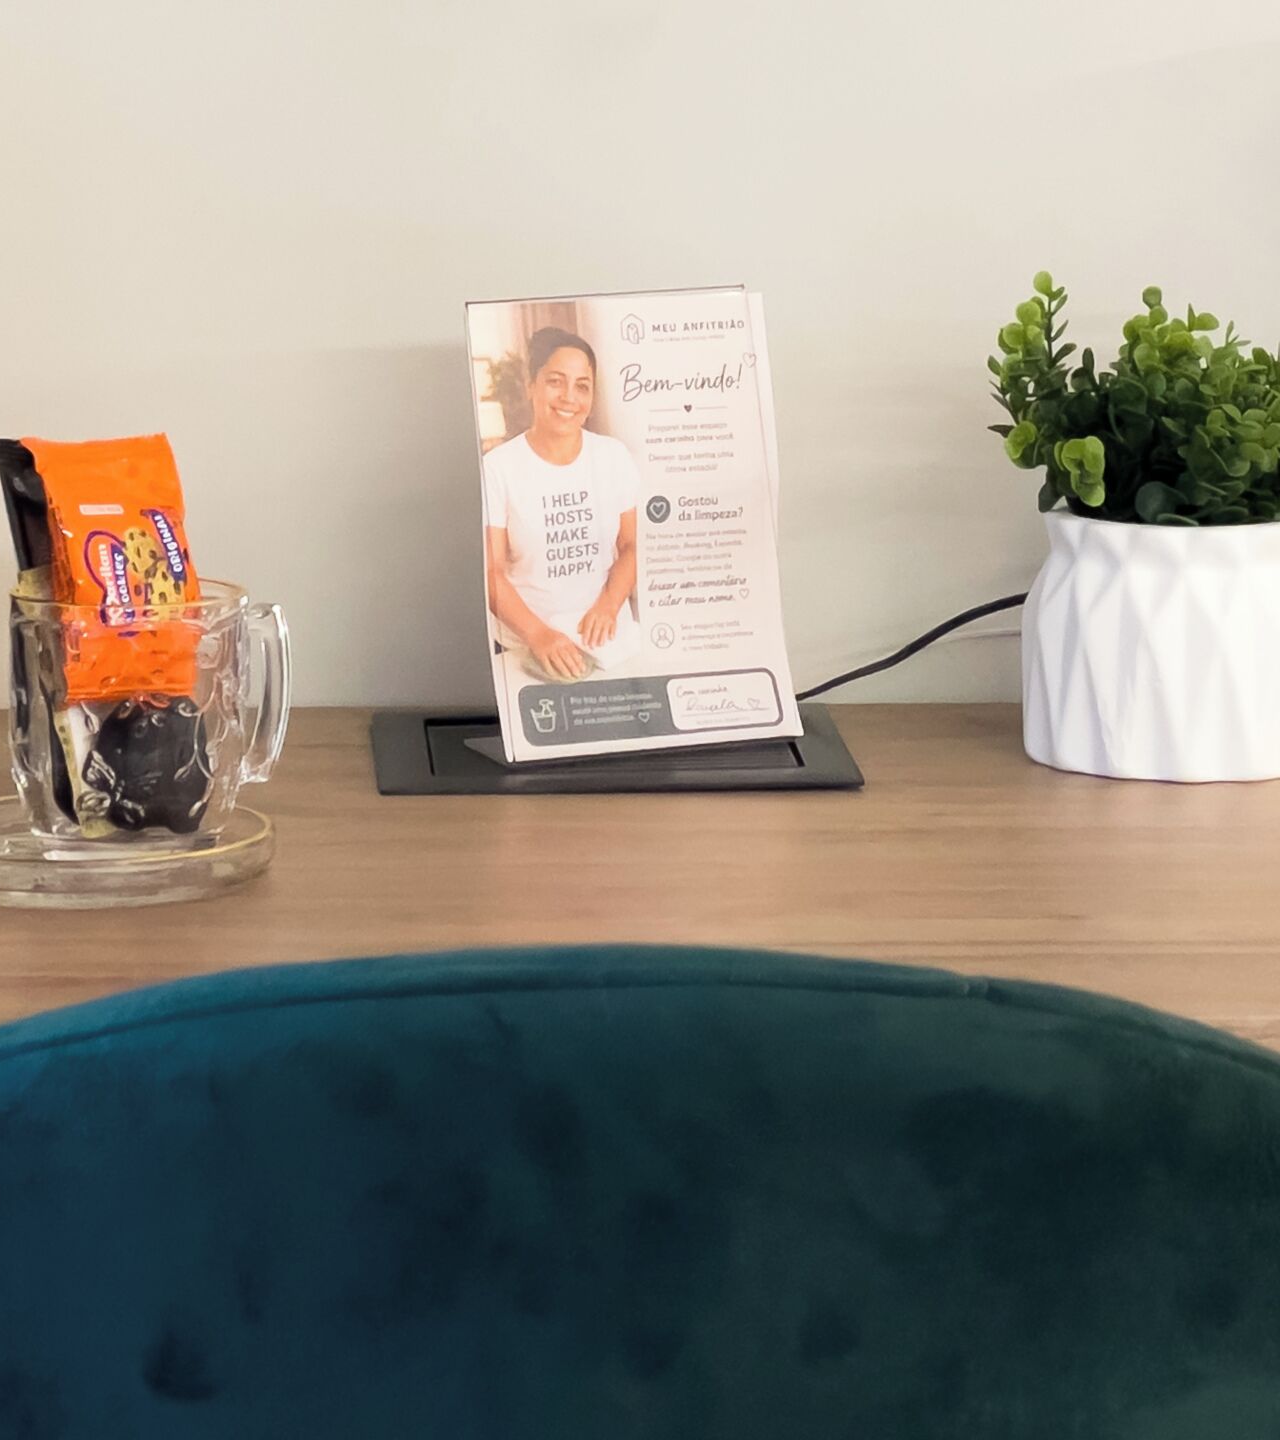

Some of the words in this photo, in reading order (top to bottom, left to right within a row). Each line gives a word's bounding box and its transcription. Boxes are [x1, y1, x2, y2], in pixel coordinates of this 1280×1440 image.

[651, 323, 677, 333] MEU
[619, 363, 743, 402] Bem-vindo!
[551, 490, 589, 508] HELP
[678, 496, 719, 507] Gostou
[544, 508, 593, 527] HOSTS
[678, 510, 692, 521] da
[694, 506, 744, 521] limpeza?
[546, 526, 589, 545] MAKE
[546, 542, 599, 561] GUESTS
[547, 560, 595, 578] HAPPY.
